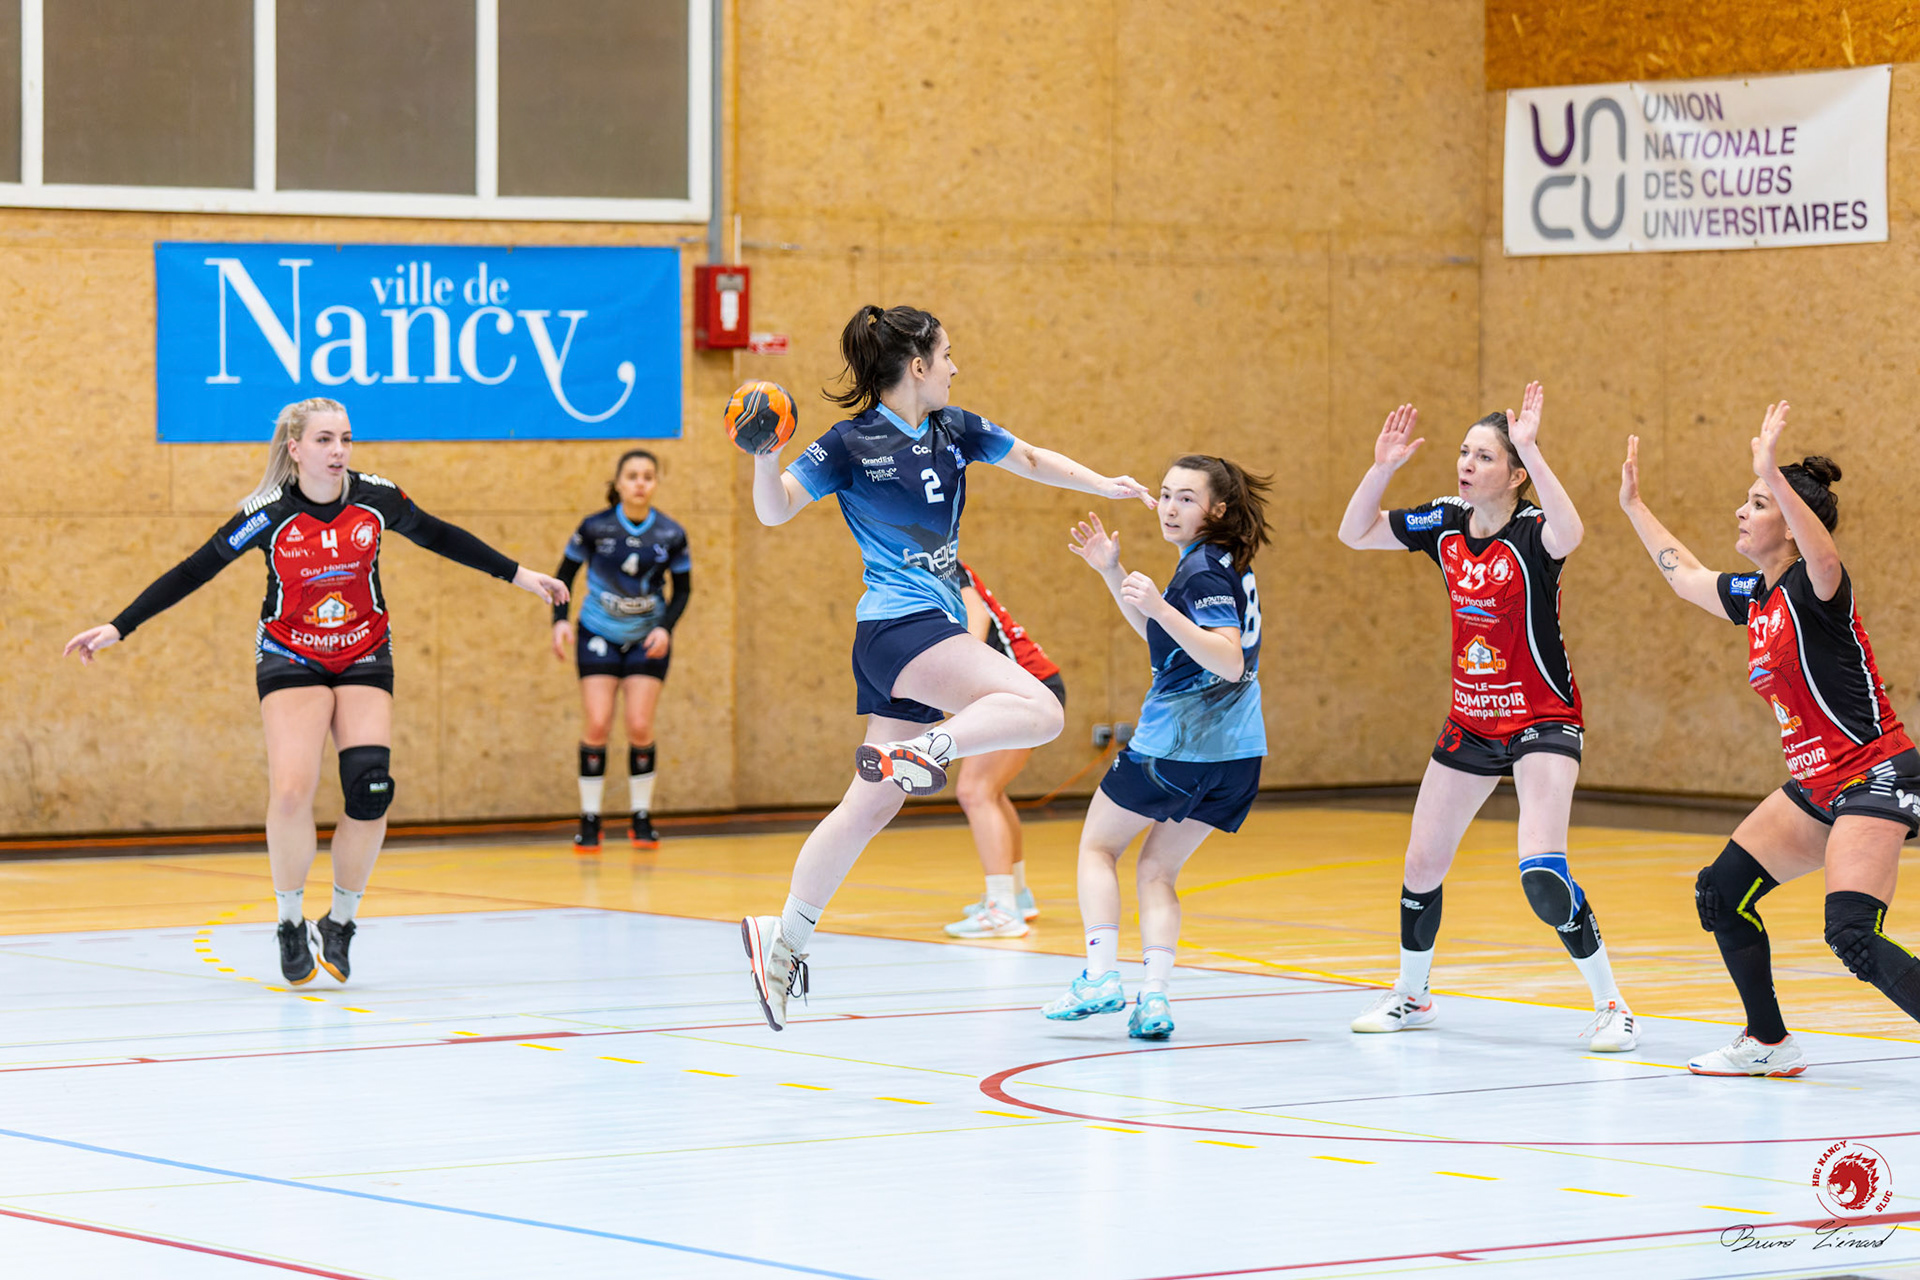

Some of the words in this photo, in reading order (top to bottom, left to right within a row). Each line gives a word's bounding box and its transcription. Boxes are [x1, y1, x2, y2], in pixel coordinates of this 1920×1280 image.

[1643, 92, 1724, 123] UNION
[1643, 126, 1798, 161] NATIONALE
[1643, 169, 1694, 200] DES
[1701, 165, 1793, 199] CLUBS
[1643, 201, 1869, 240] UNIVERSITAIRES
[370, 260, 455, 306] ville
[462, 262, 511, 306] de
[203, 257, 637, 423] Nancy
[920, 467, 945, 504] 2
[320, 528, 339, 558] 4
[300, 567, 322, 577] Guy
[323, 560, 361, 572] Hoquet
[1457, 559, 1487, 590] 23
[1241, 572, 1262, 650] 8
[1451, 590, 1465, 606] Guy
[1465, 595, 1497, 608] Hoquet
[1750, 615, 1769, 649] 17
[1454, 689, 1526, 708] COMPTOIR
[1475, 682, 1488, 691] LE
[1463, 706, 1512, 720] Campanile
[1785, 743, 1796, 754] LE
